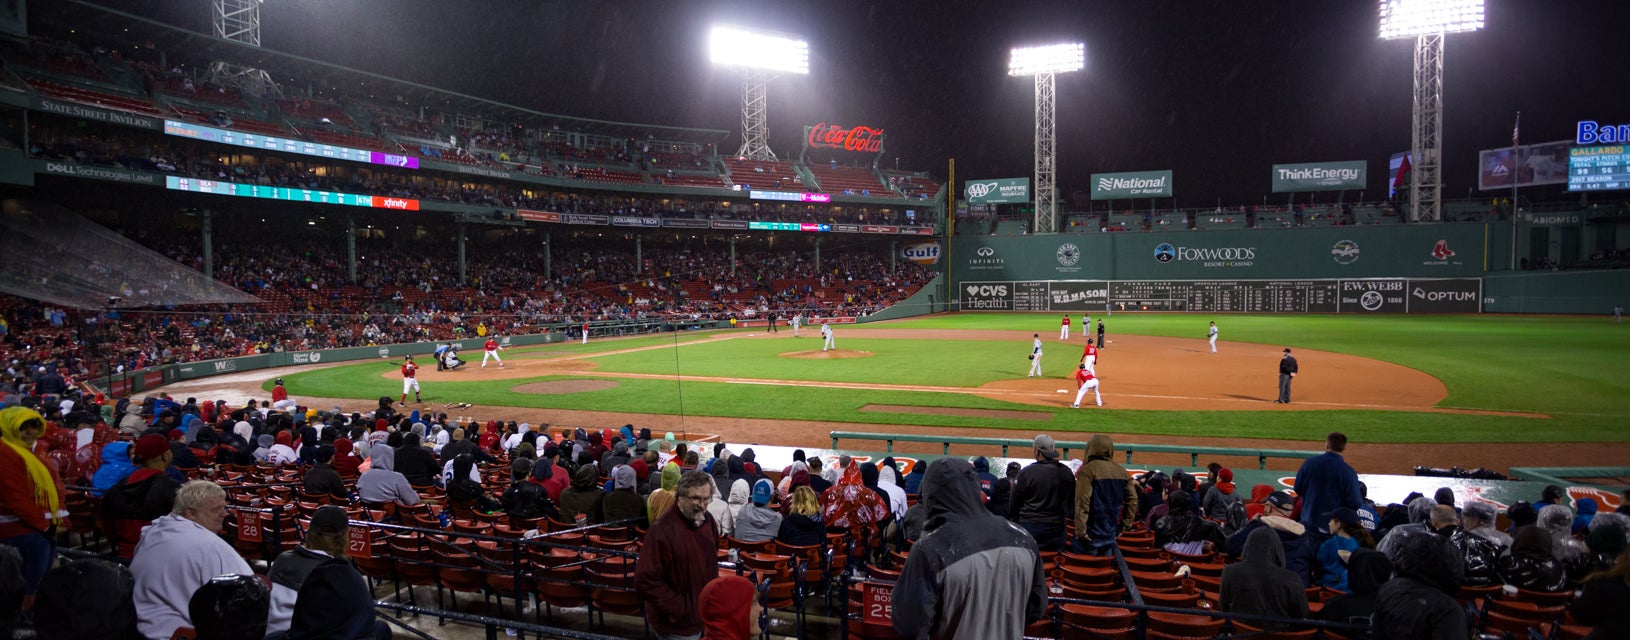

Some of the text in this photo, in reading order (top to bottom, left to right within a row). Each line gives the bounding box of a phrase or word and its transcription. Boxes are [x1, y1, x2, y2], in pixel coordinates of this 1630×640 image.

[42, 101, 151, 128] STATE STREET PAVILION
[1572, 146, 1624, 156] GALLARDO
[46, 163, 153, 183] DELL Technologies Level
[1278, 168, 1358, 180] ThinkEnergy
[1112, 176, 1165, 189] National
[384, 198, 408, 209] xfinity
[1533, 216, 1578, 224] ABIOMED
[903, 246, 938, 257] Gulf
[1178, 247, 1255, 260] FOXWOODS
[980, 285, 1008, 297] CVS
[1344, 282, 1403, 291] F.W. WEBB
[1427, 292, 1475, 301] OPTUM
[968, 297, 1008, 308] Health
[243, 525, 258, 536] 28
[350, 540, 366, 551] 27
[871, 586, 892, 595] FIEL
[871, 604, 892, 619] 25
